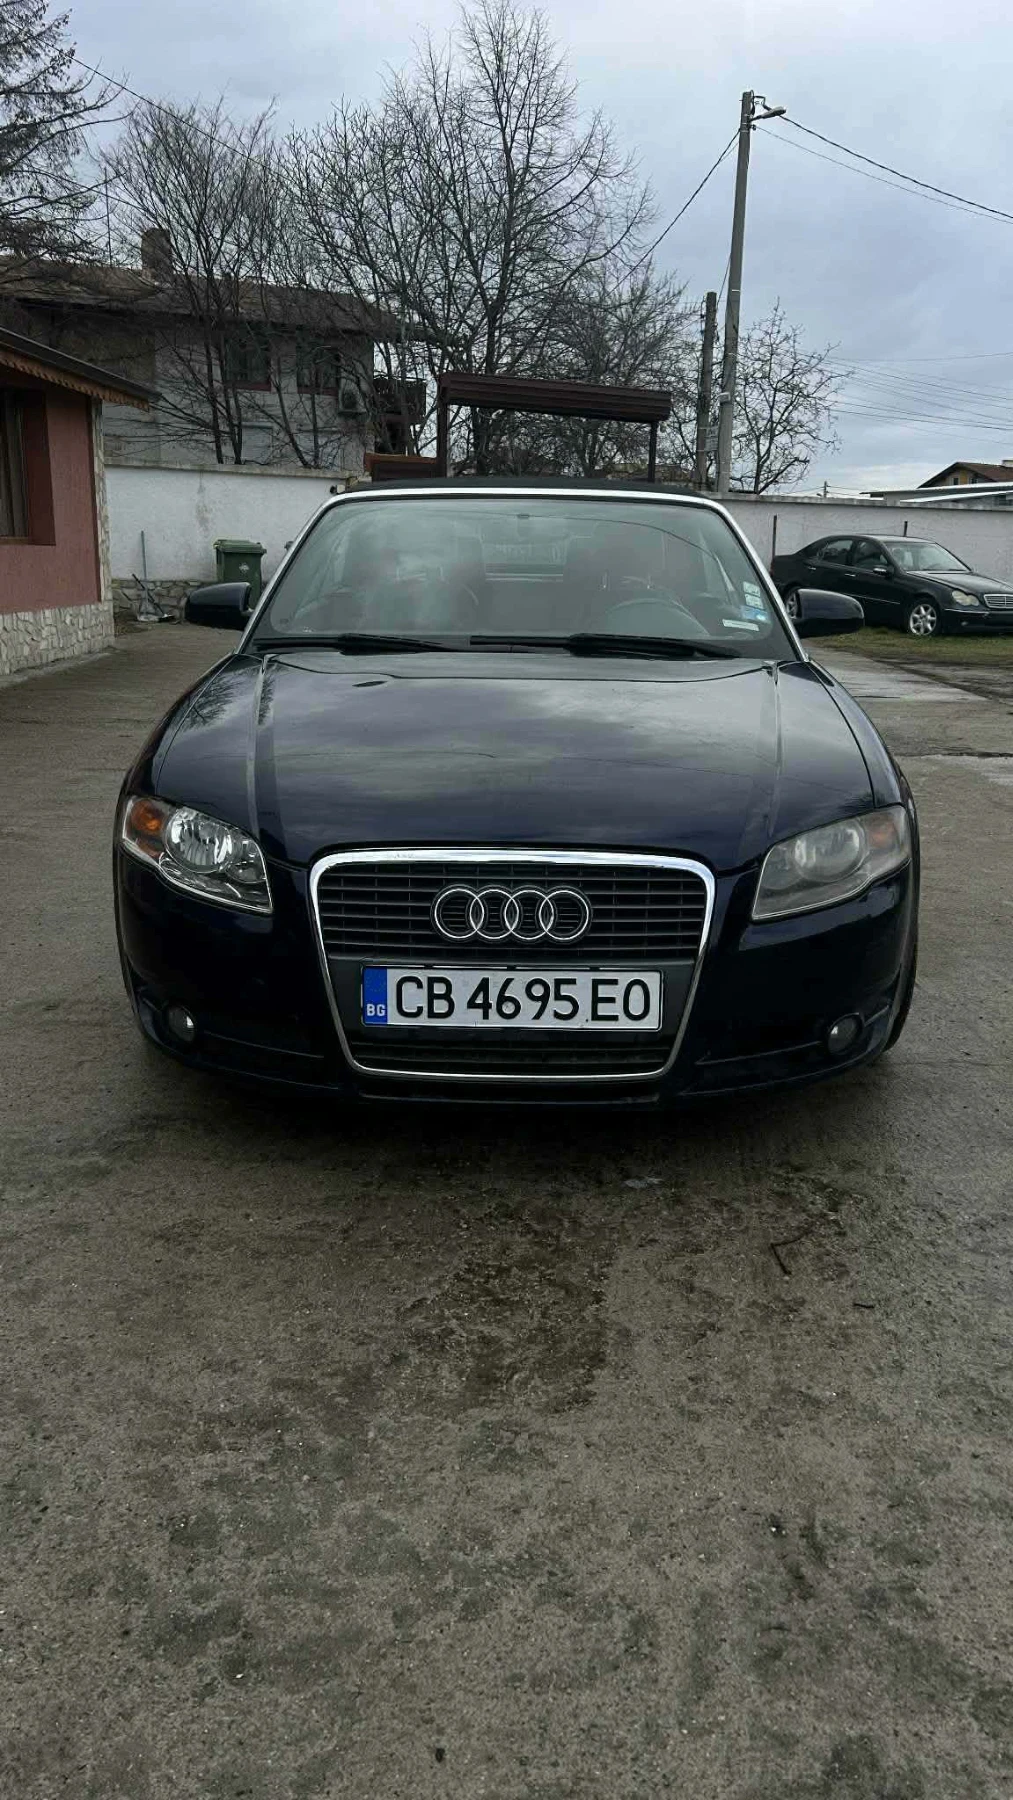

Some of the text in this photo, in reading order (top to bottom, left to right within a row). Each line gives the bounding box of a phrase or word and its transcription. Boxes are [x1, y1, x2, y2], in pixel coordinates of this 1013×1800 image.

[366, 1003, 386, 1017] BG
[396, 975, 455, 1019] CB
[466, 977, 580, 1021] 4695
